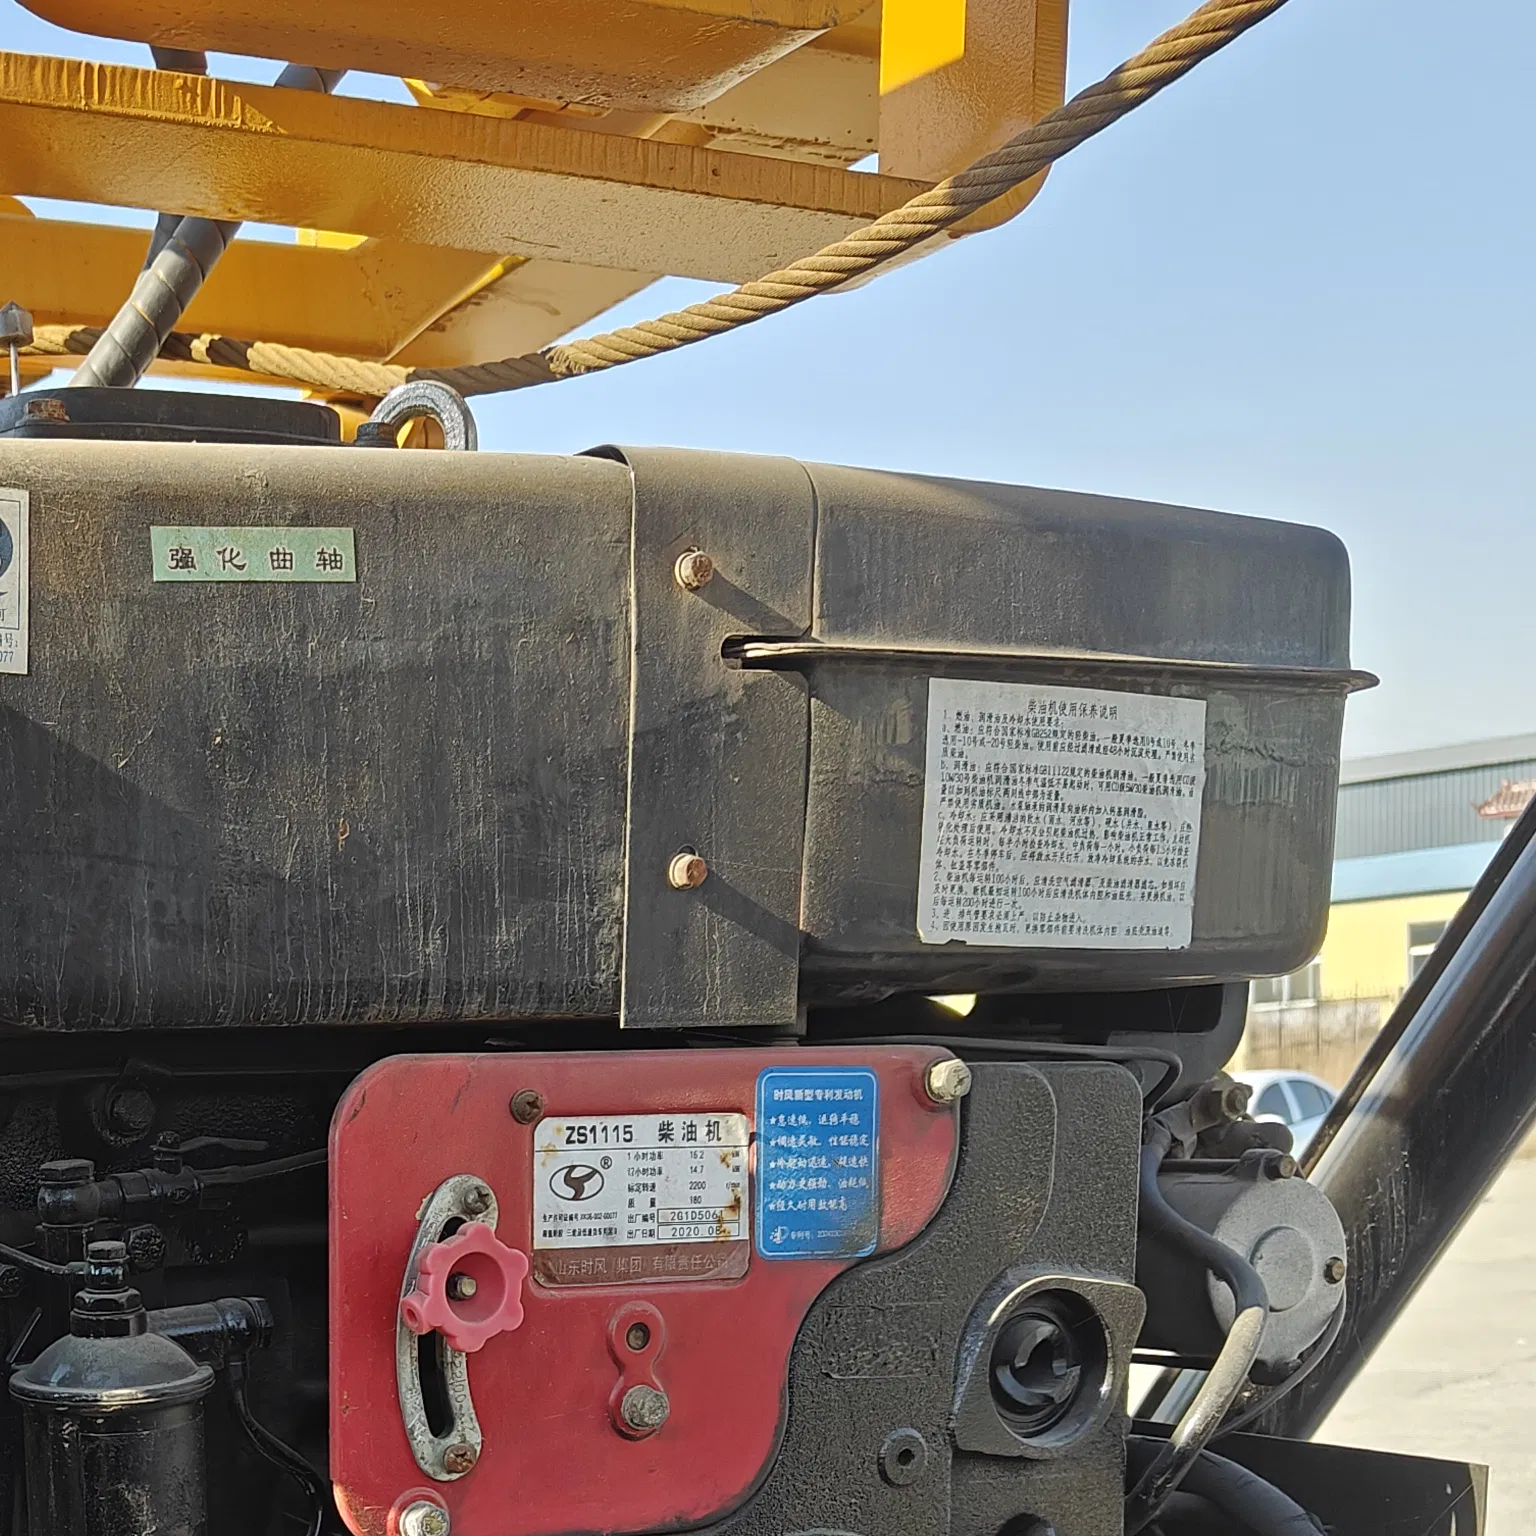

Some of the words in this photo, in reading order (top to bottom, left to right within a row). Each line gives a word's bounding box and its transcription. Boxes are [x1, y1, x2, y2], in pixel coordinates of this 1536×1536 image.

[167, 547, 344, 572] 强化曲轴
[565, 1124, 633, 1145] ZS1115
[658, 1121, 722, 1143] 柴油机
[689, 1181, 706, 1190] 2200
[689, 1195, 702, 1204] 180
